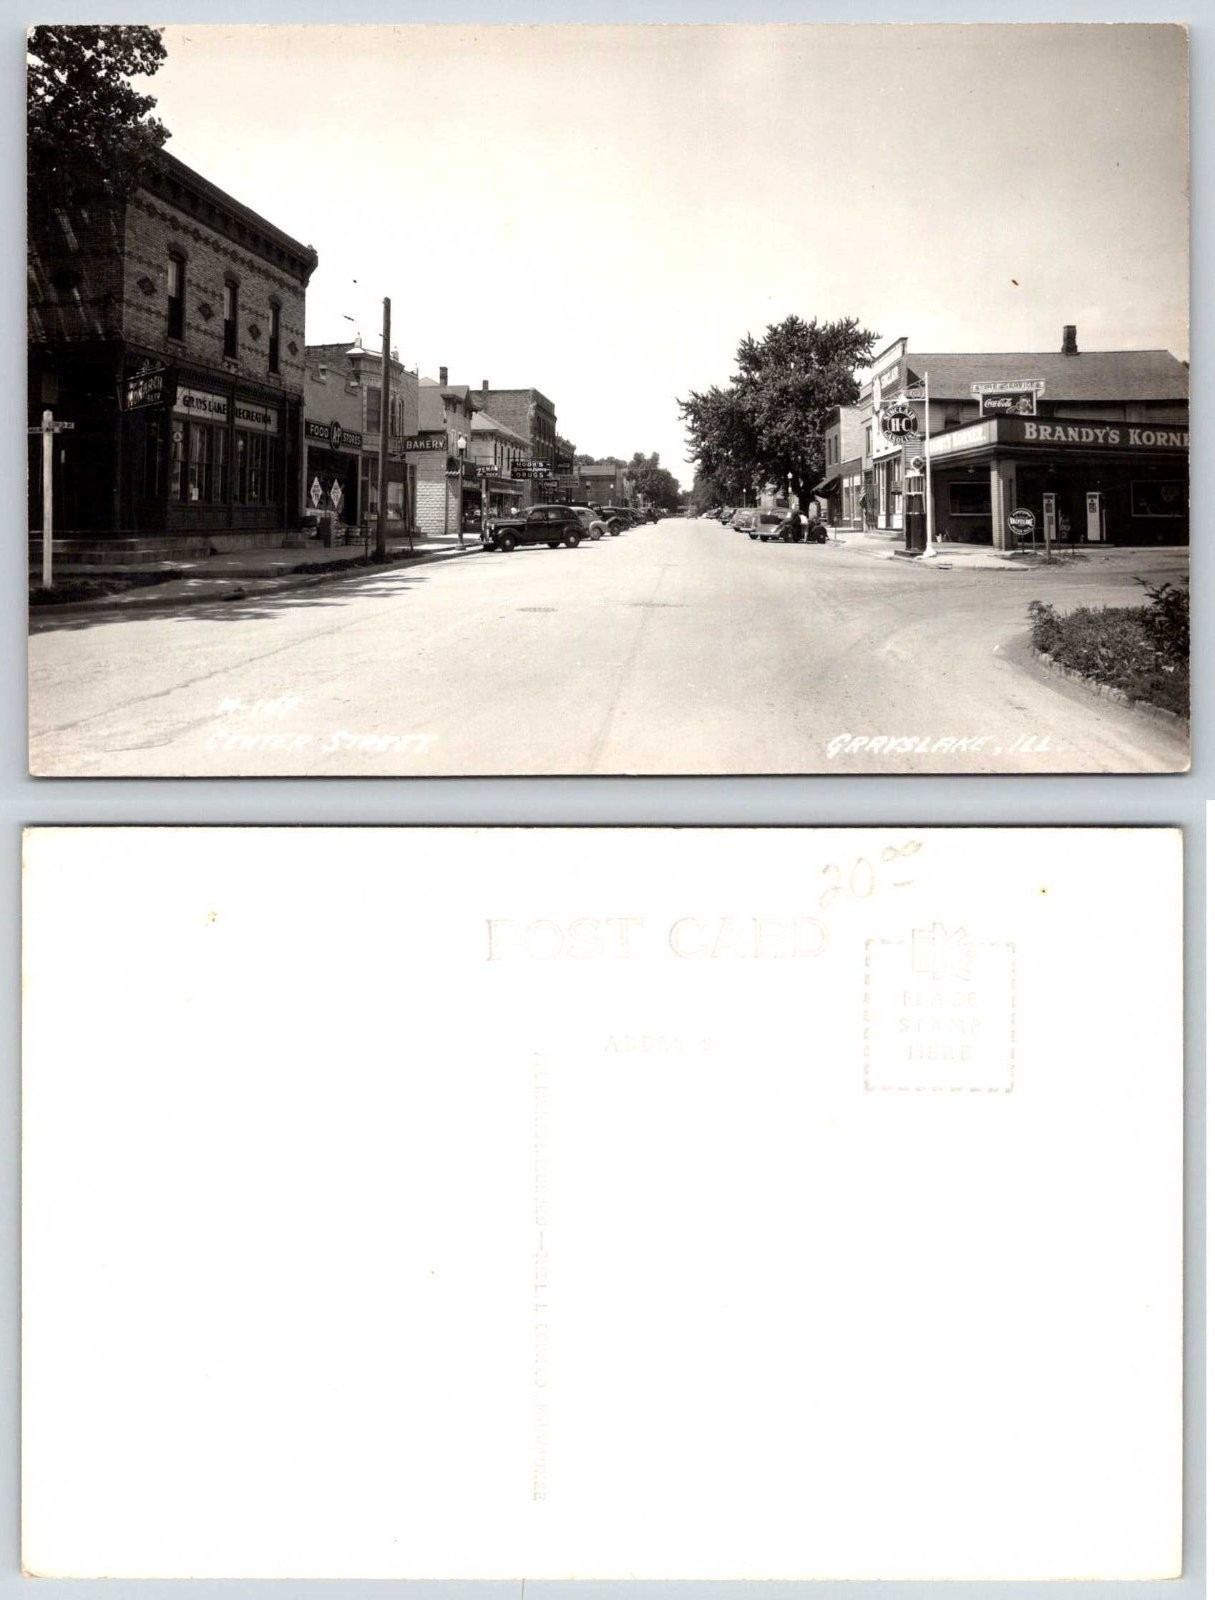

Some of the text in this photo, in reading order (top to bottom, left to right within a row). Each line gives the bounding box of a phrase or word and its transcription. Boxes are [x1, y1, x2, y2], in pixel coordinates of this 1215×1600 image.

[984, 397, 1013, 408] Coca-Cola
[883, 406, 916, 421] SINCLAIR
[310, 424, 329, 439] FOOD
[343, 432, 361, 445] STORES
[1024, 422, 1120, 444] BRANDY'S
[406, 439, 445, 449] BAKERY
[484, 917, 831, 961] POST CARD
